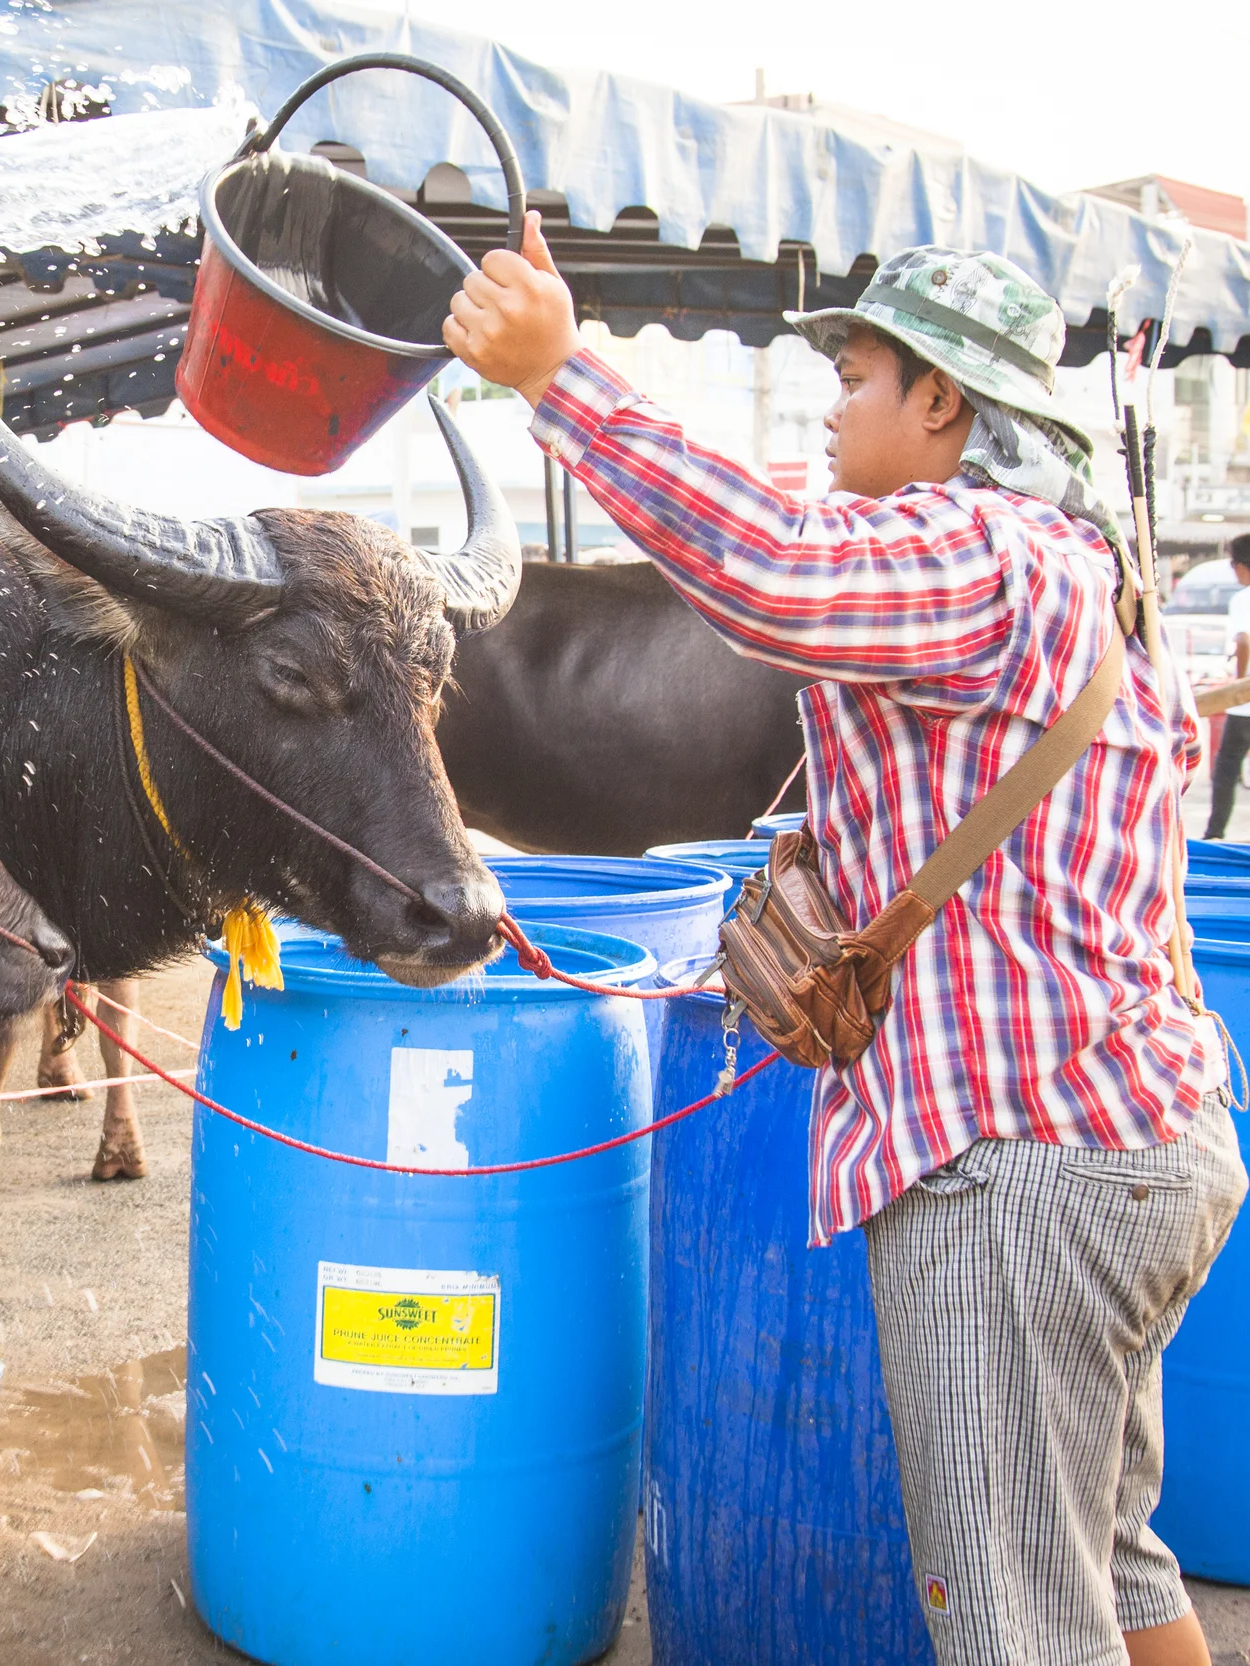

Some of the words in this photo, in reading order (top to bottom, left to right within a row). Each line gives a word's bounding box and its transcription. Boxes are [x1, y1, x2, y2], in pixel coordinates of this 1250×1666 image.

[378, 1307, 438, 1323] SUNSWEET
[333, 1328, 368, 1340] PRUNE
[370, 1332, 400, 1343] JUICE
[403, 1335, 483, 1345] CONCENTRATE
